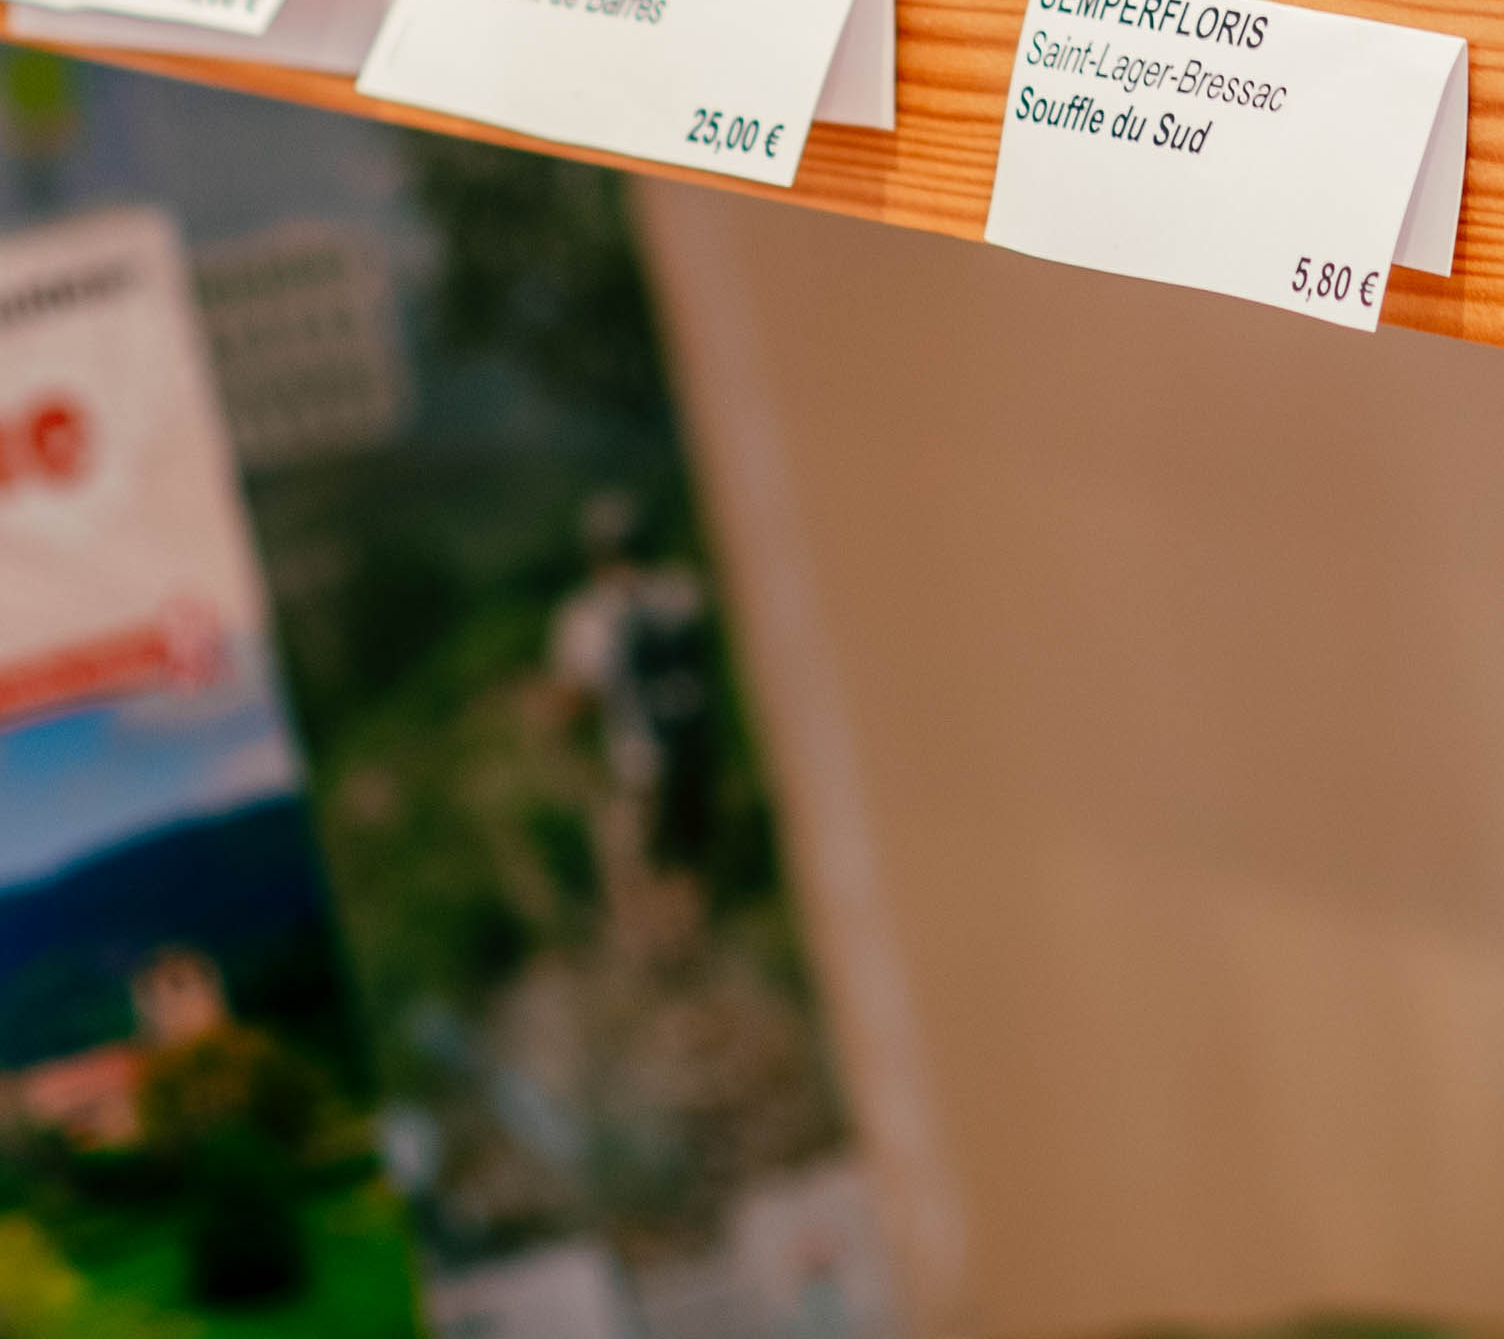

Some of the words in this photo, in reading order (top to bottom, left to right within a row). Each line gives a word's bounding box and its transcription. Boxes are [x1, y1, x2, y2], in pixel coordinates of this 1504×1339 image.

[1026, 29, 1288, 114] Saint-Lager-Bressac
[686, 108, 761, 156] 25,00
[765, 122, 786, 159] €
[1015, 85, 1106, 135] Souffle
[1111, 104, 1144, 143] du
[1152, 112, 1214, 155] Sud
[1291, 255, 1352, 304] 5,80
[1359, 270, 1380, 308] €
